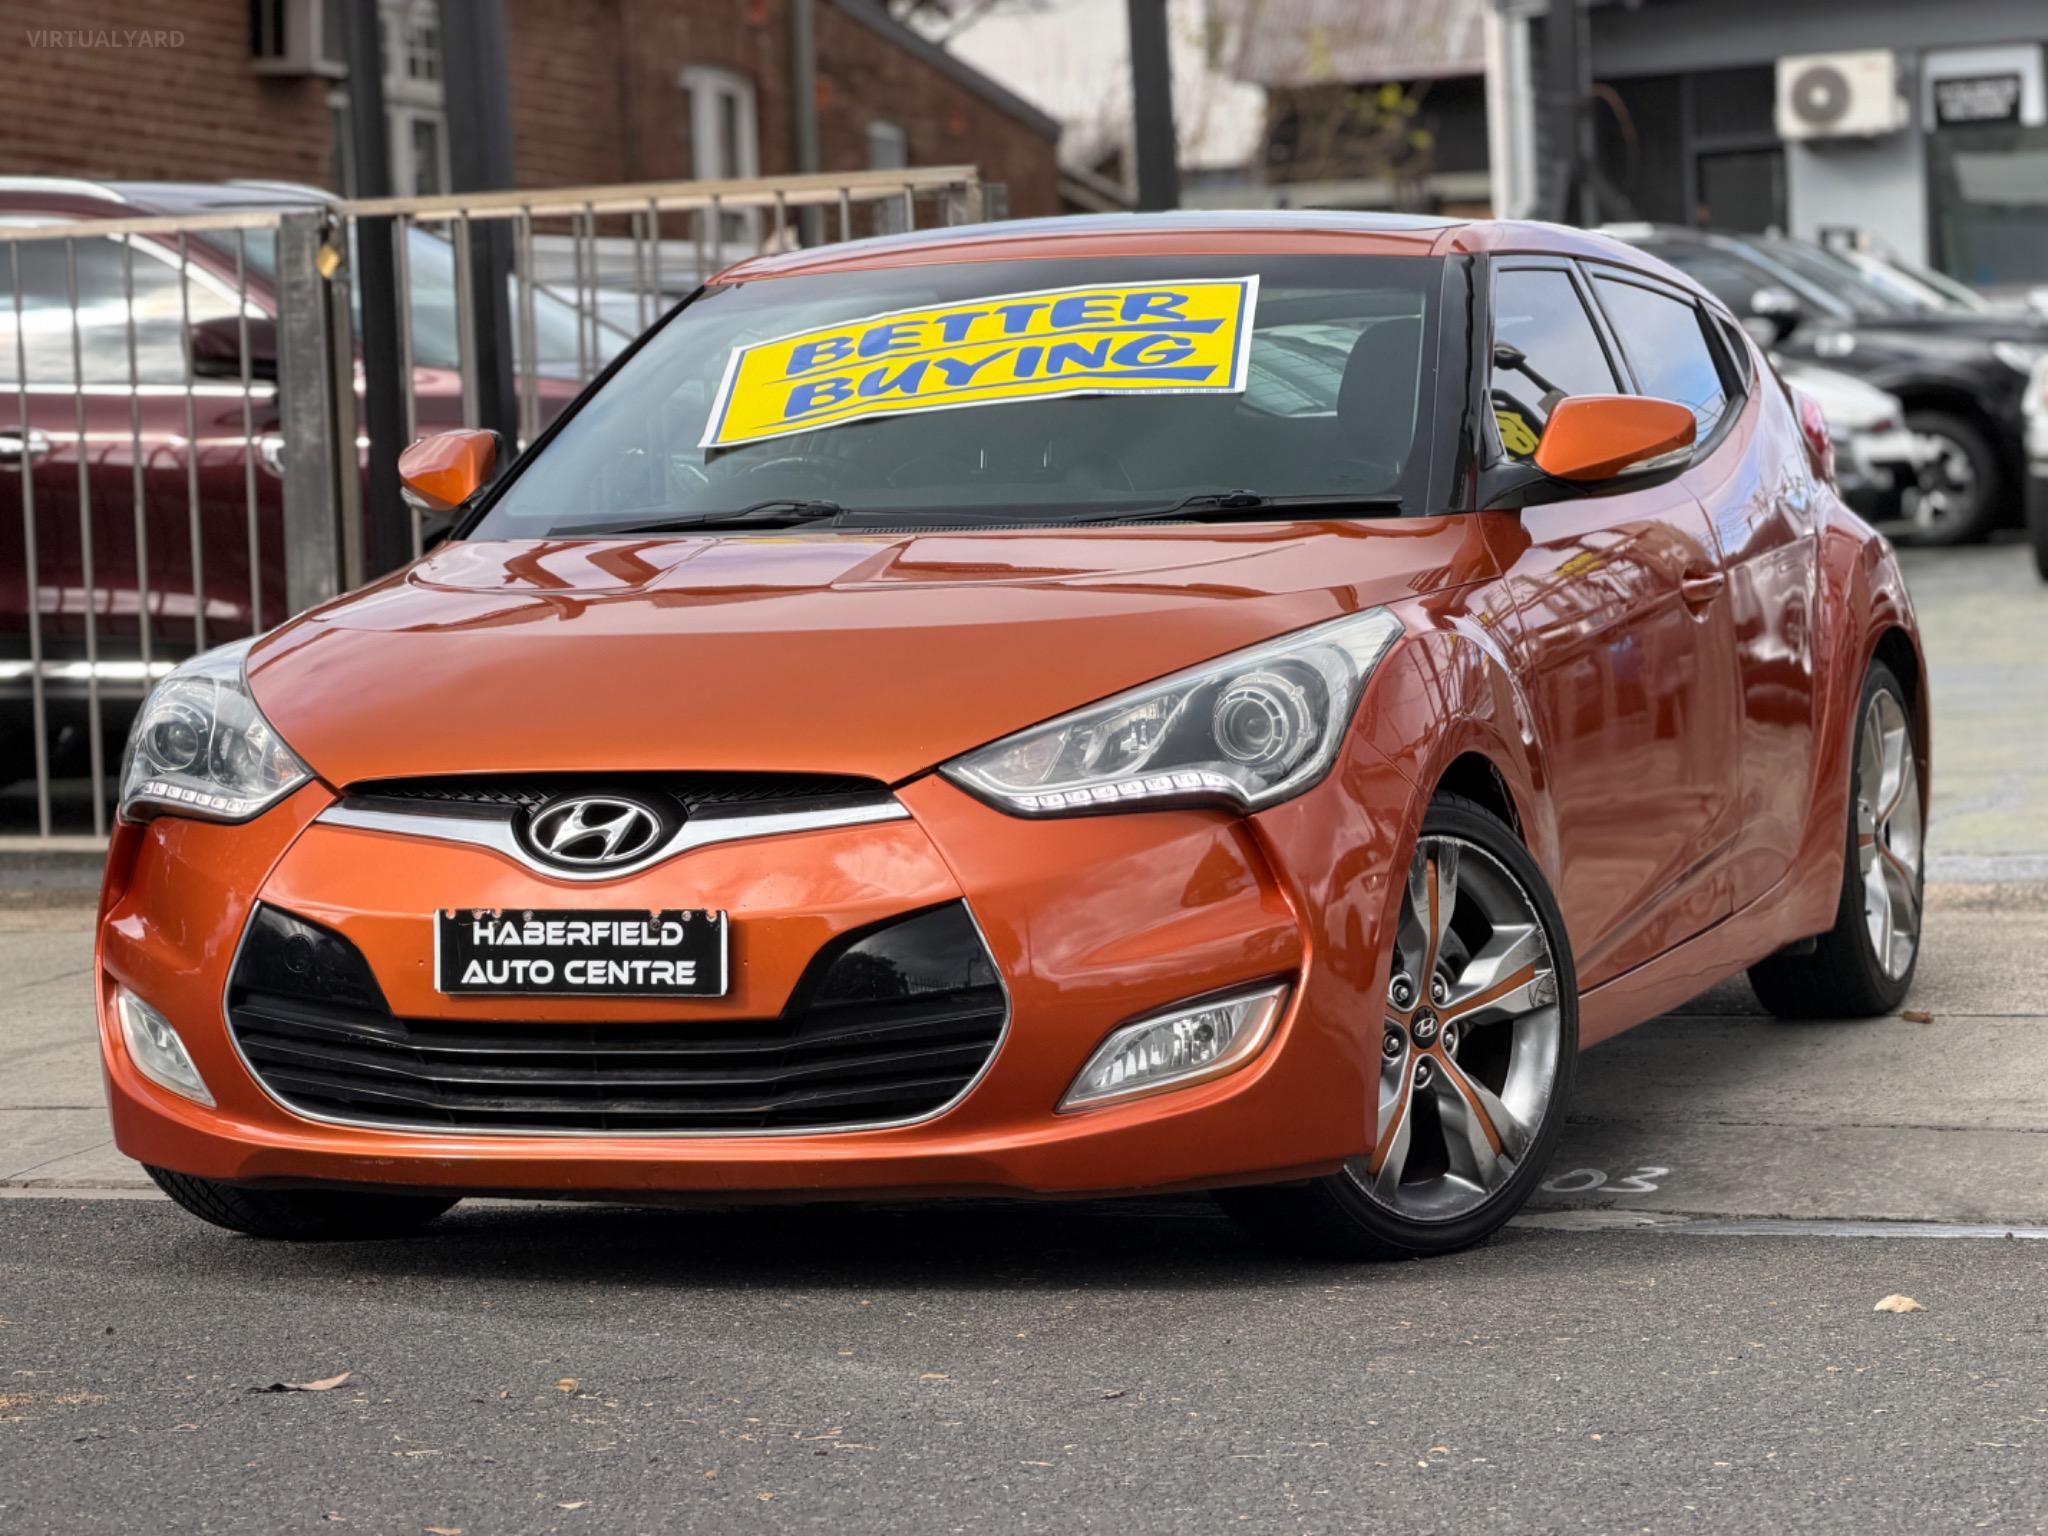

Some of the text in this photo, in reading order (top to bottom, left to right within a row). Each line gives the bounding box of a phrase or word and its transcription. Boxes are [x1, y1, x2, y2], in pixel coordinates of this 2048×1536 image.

[787, 291, 1190, 375] BETTER
[784, 333, 1198, 418] BUYING
[473, 921, 684, 946] HABERFIELD
[461, 960, 697, 985] AUTO CENTRE
